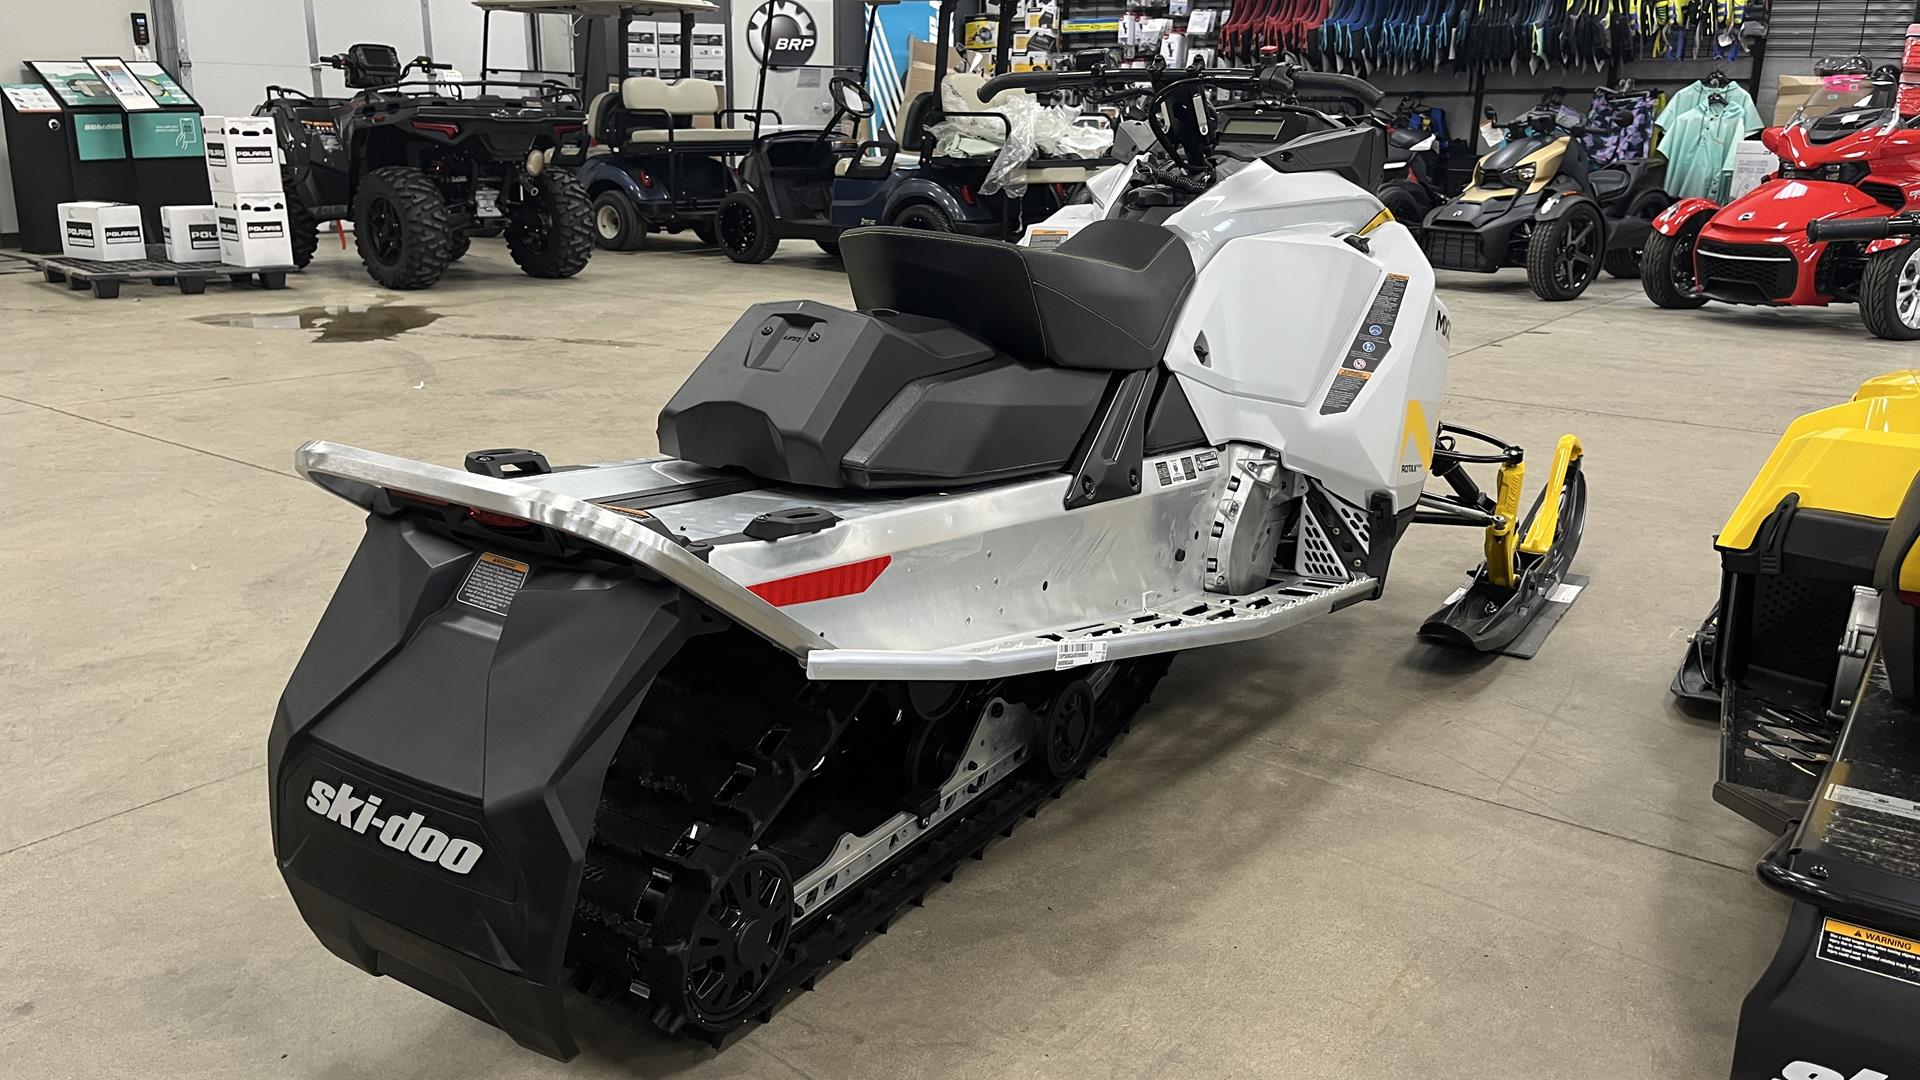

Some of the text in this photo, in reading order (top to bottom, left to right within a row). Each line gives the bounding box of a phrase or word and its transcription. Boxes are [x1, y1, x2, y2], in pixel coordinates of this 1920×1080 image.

[775, 38, 815, 51] BRP
[67, 228, 92, 237] POLARIS
[191, 230, 219, 239] POL
[306, 780, 484, 875] ski-doo
[1865, 932, 1912, 951] WARNING
